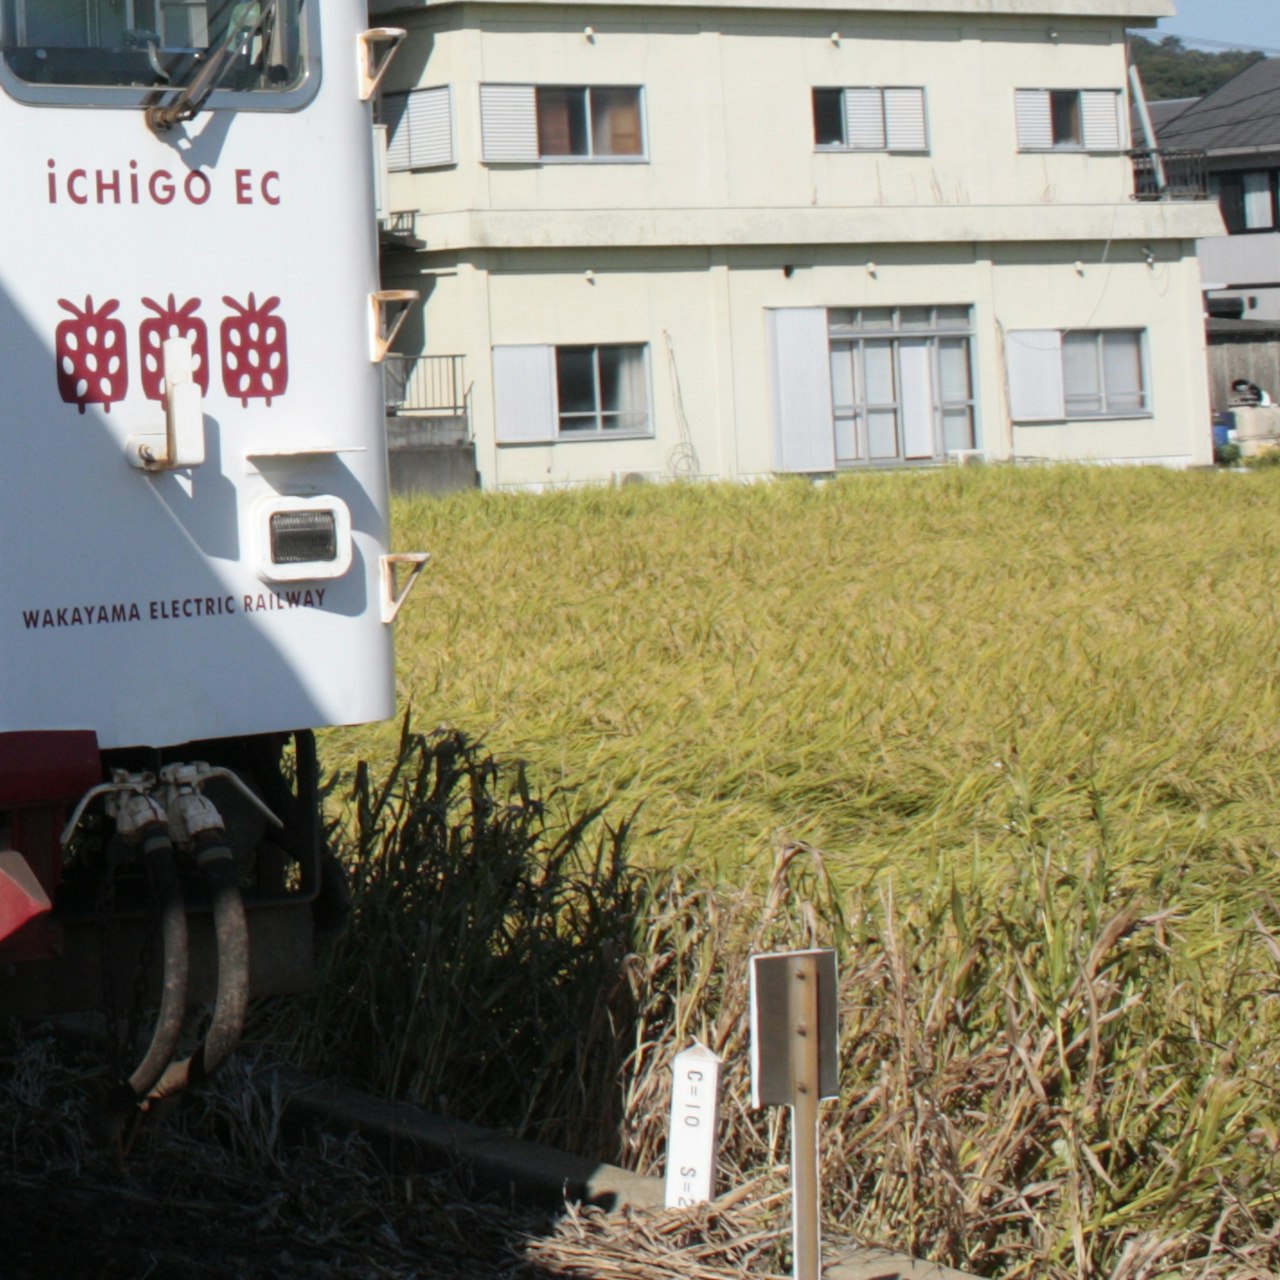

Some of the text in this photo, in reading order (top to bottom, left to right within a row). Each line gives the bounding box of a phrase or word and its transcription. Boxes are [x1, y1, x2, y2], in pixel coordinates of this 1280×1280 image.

[234, 168, 281, 206] EC
[22, 587, 327, 630] WAKAYAMA ELECTRIC RAILWAY
